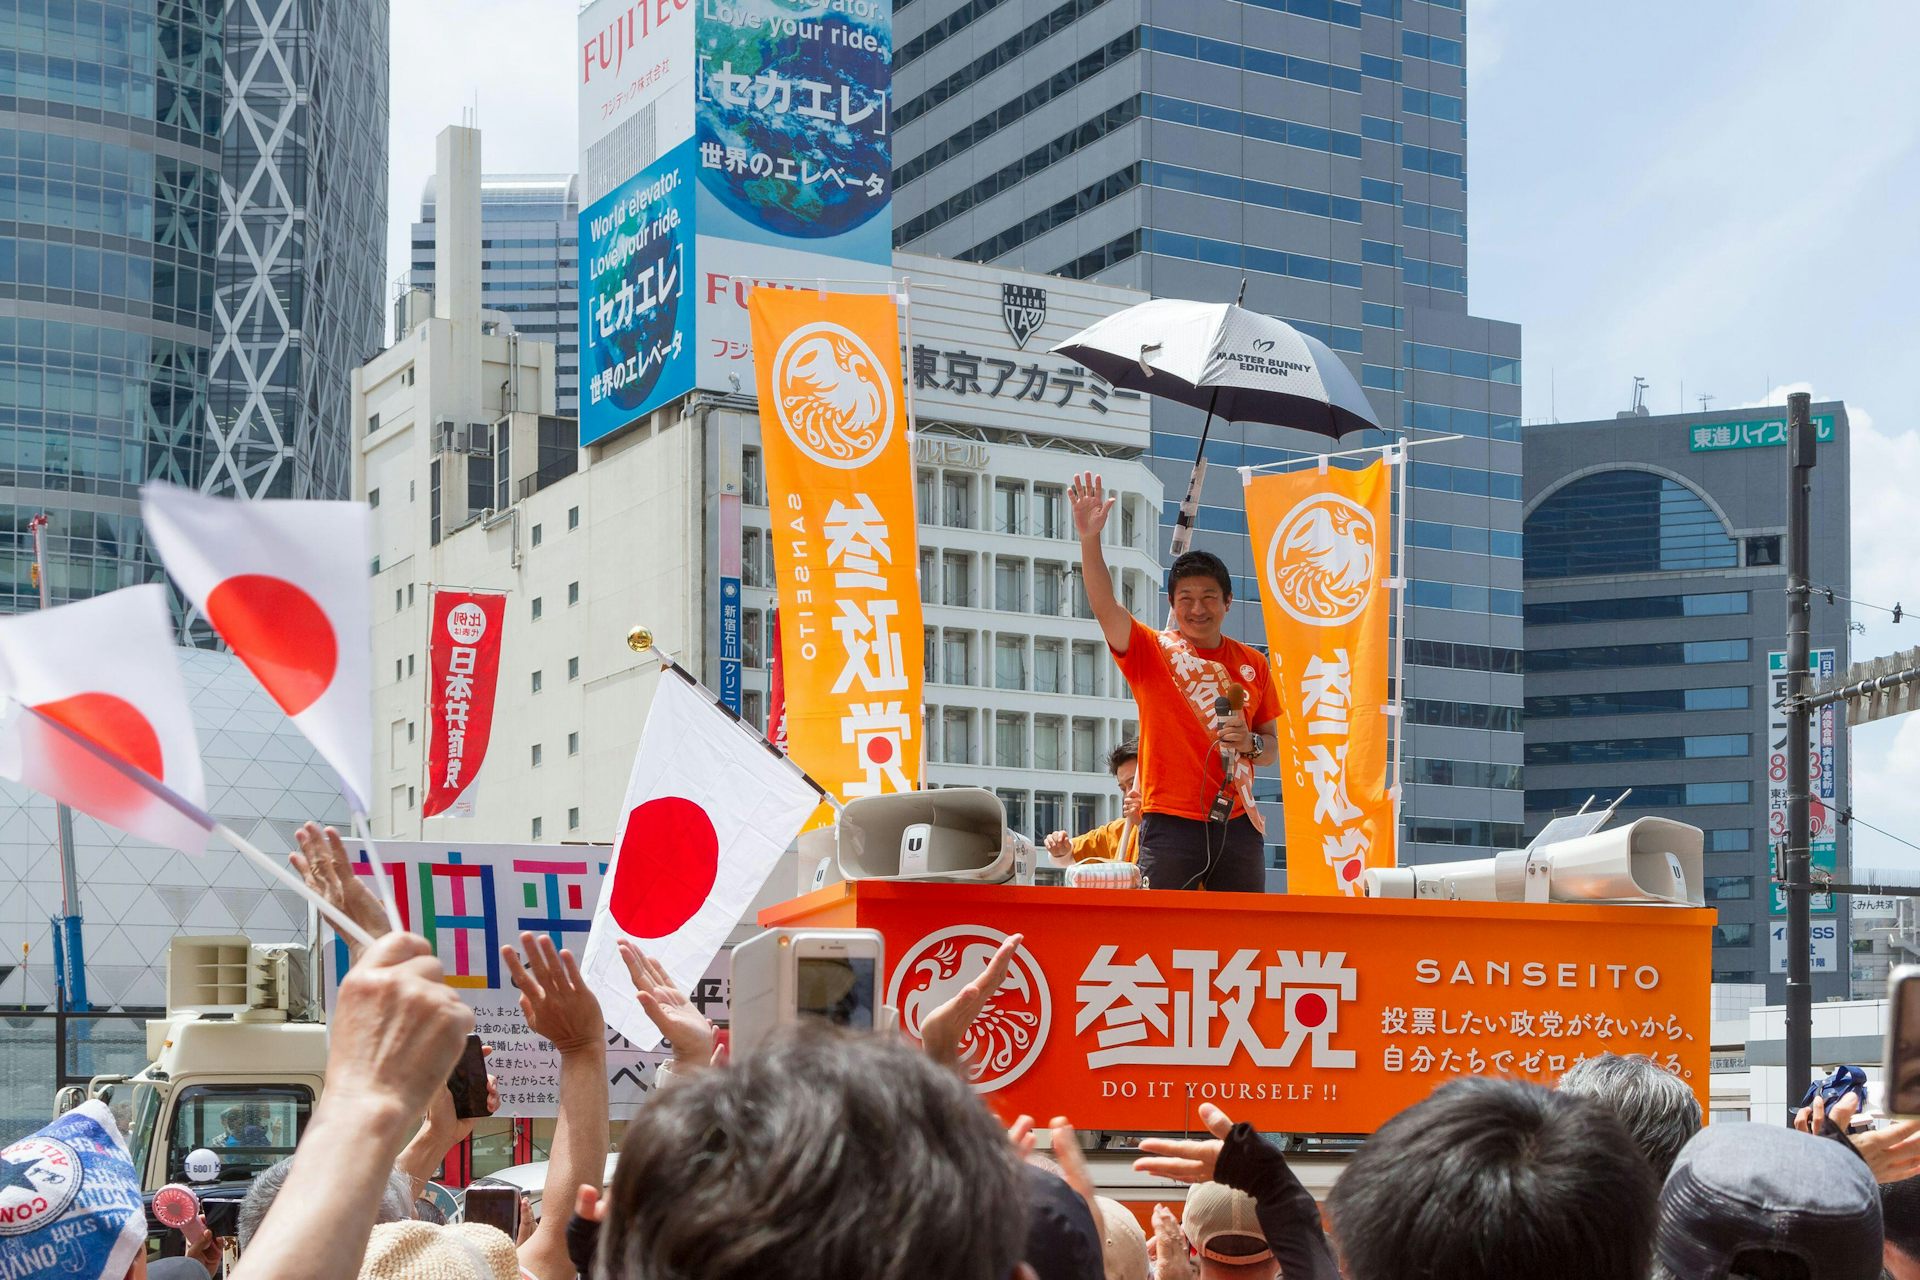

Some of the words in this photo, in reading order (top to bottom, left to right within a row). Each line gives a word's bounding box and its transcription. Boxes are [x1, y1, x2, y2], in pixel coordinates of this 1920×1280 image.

[583, 0, 690, 85] FUJITE
[703, 0, 762, 28] Love
[769, 16, 823, 41] your
[832, 25, 887, 53] ride.
[700, 142, 885, 197] 世界のエレベータ
[590, 199, 626, 242] World
[628, 168, 681, 218] elevator.
[590, 248, 618, 281] Love
[620, 226, 650, 267] your
[652, 207, 681, 241] ride.
[1003, 295, 1046, 308] ACADEMY
[1004, 285, 1046, 299] TOKYO
[589, 330, 682, 405] 世界のエレベータ
[902, 344, 1141, 414] 東京アカデミー
[1216, 352, 1265, 365] MASTER
[1268, 358, 1311, 373] BUNNY
[1239, 363, 1288, 377] EDITION
[1693, 418, 1830, 448] 東進ハイスル
[1415, 958, 1660, 990] SANSEITO
[1075, 945, 1358, 1070] 参政党
[1381, 1006, 1694, 1041] 投票したい政党がないから、
[500, 1092, 560, 1104] できる社会を。
[1102, 1081, 1137, 1098] DO
[1147, 1081, 1174, 1098] IT
[1185, 1082, 1314, 1100] YOURSELF
